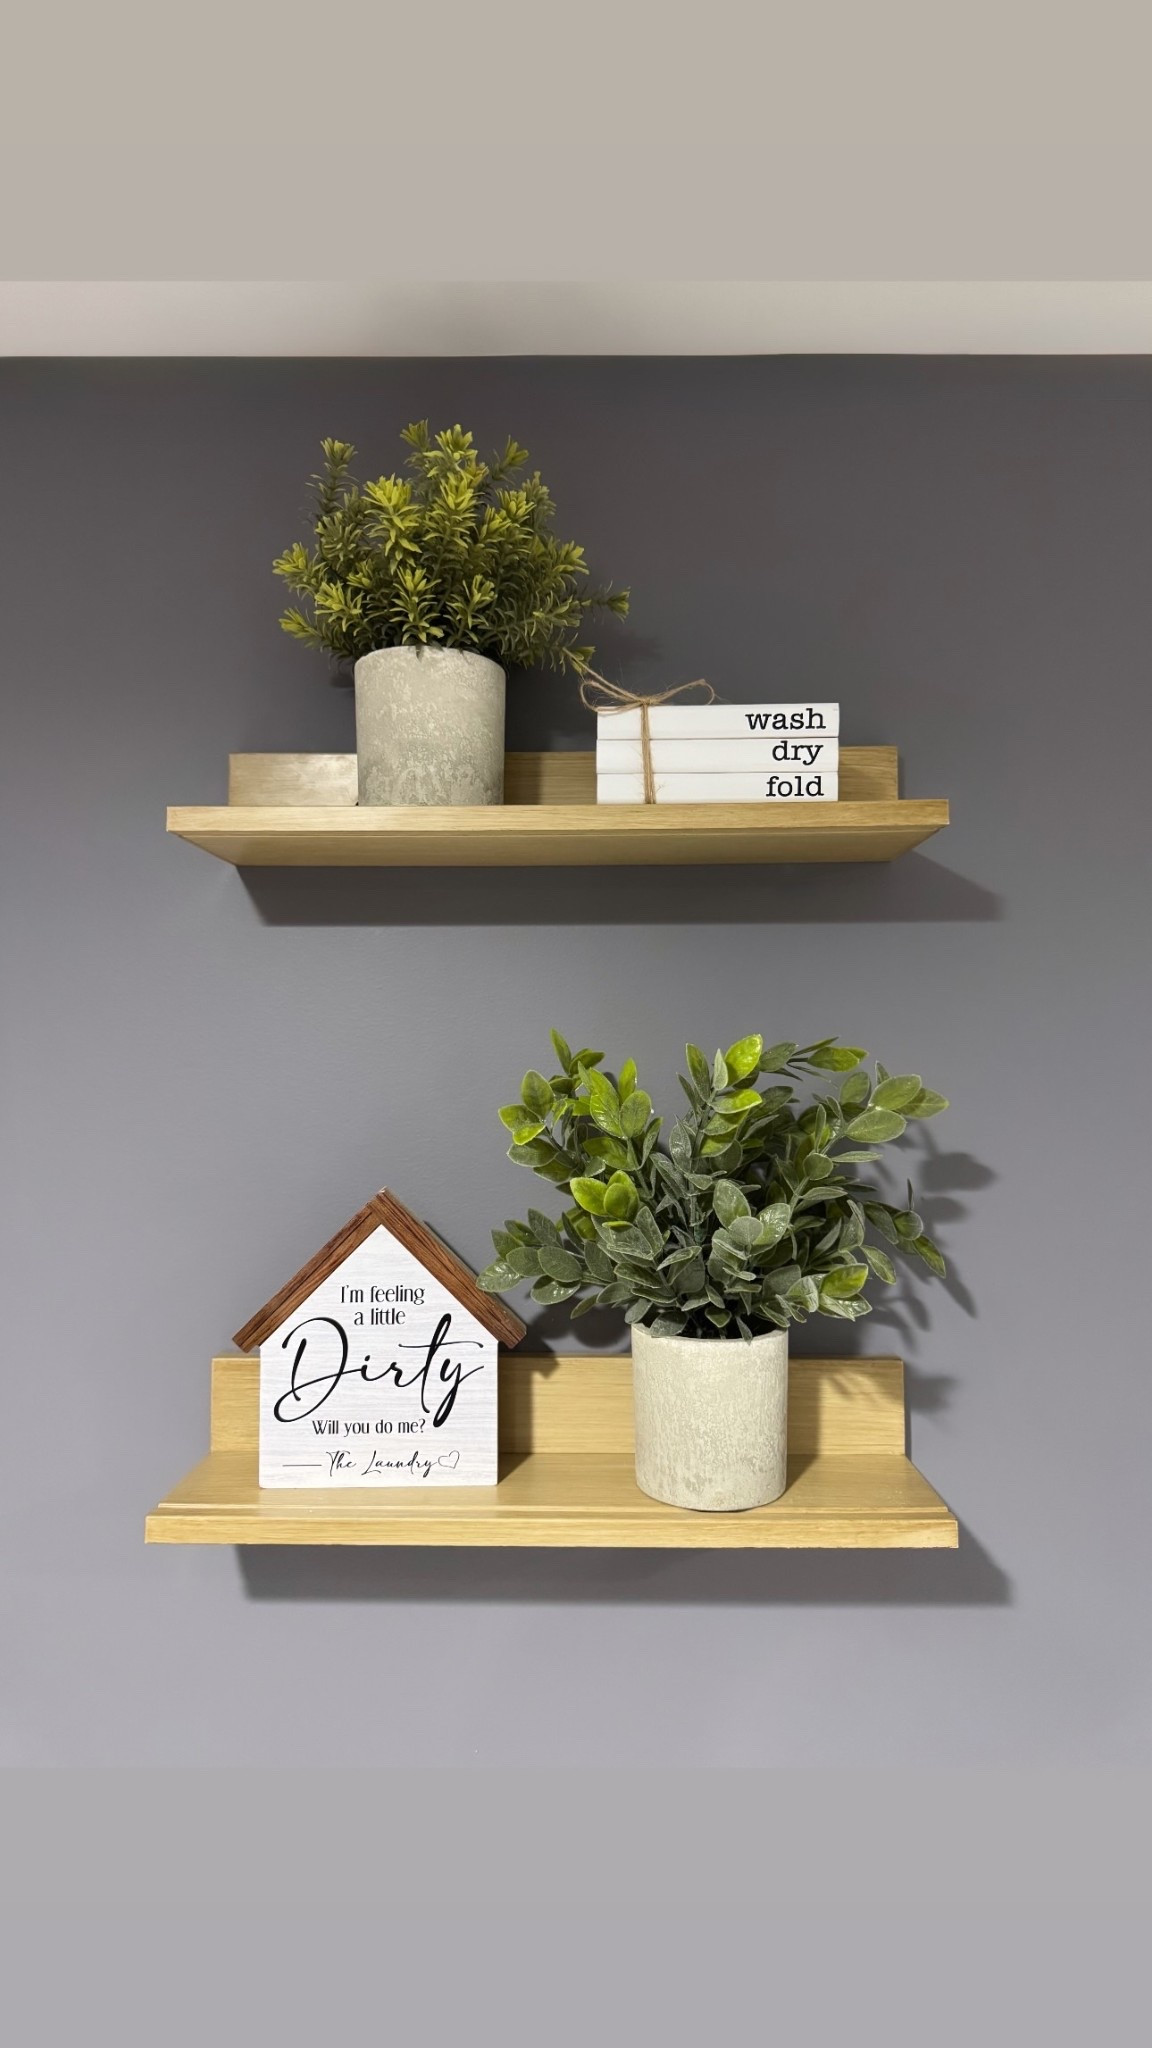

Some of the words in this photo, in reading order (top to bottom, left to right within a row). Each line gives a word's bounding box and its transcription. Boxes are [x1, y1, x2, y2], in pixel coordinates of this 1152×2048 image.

[744, 707, 827, 731] wash
[772, 740, 824, 766] dry
[765, 775, 825, 797] fold
[340, 1285, 364, 1304] I'm
[370, 1285, 425, 1305] feeling
[353, 1311, 364, 1326] a
[370, 1308, 406, 1326] little
[273, 1312, 485, 1428] Dirty
[312, 1419, 339, 1435] Will
[343, 1422, 370, 1437] you
[375, 1419, 393, 1434] do
[398, 1418, 426, 1434] me?
[326, 1450, 357, 1477] The
[361, 1450, 438, 1478] Laundry
